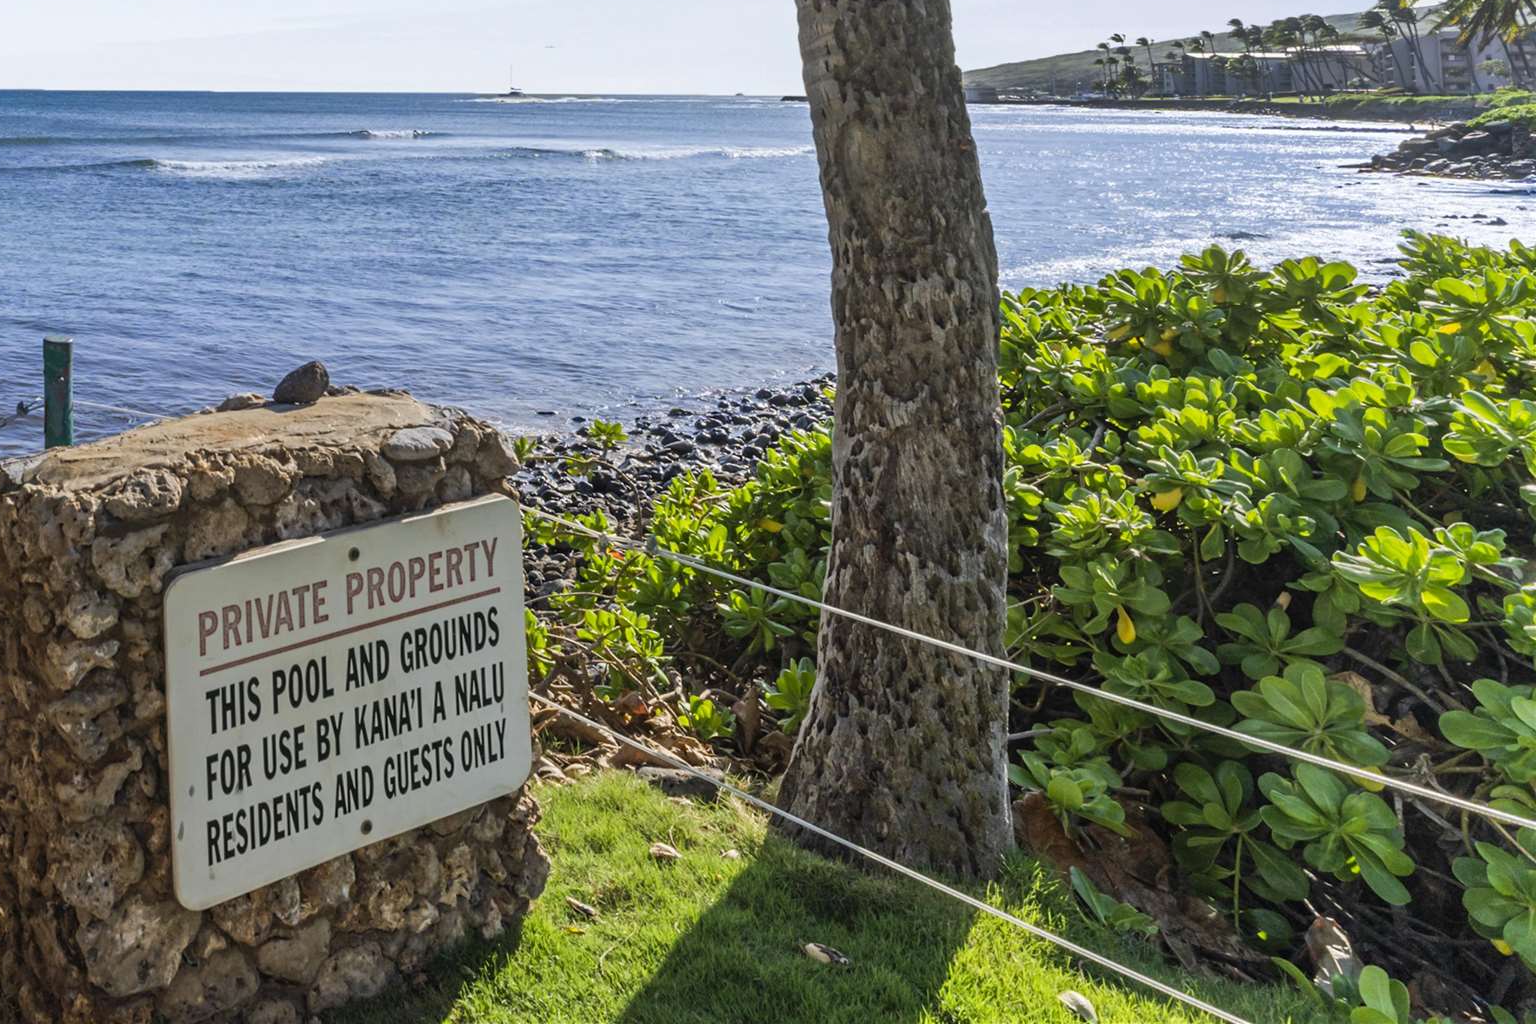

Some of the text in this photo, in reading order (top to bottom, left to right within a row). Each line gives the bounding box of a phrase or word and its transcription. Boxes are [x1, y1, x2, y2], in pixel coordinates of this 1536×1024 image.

[199, 537, 498, 656] PRIVATE PROPERTY
[206, 606, 500, 734] THIS POOL AND GROUNDS
[206, 744, 252, 800] FOR
[263, 725, 306, 779] USE
[317, 713, 344, 761] BY
[433, 681, 446, 724] A
[454, 662, 504, 715] NALU
[207, 717, 506, 866] RESIDENTS AND GUESTS ONLY
